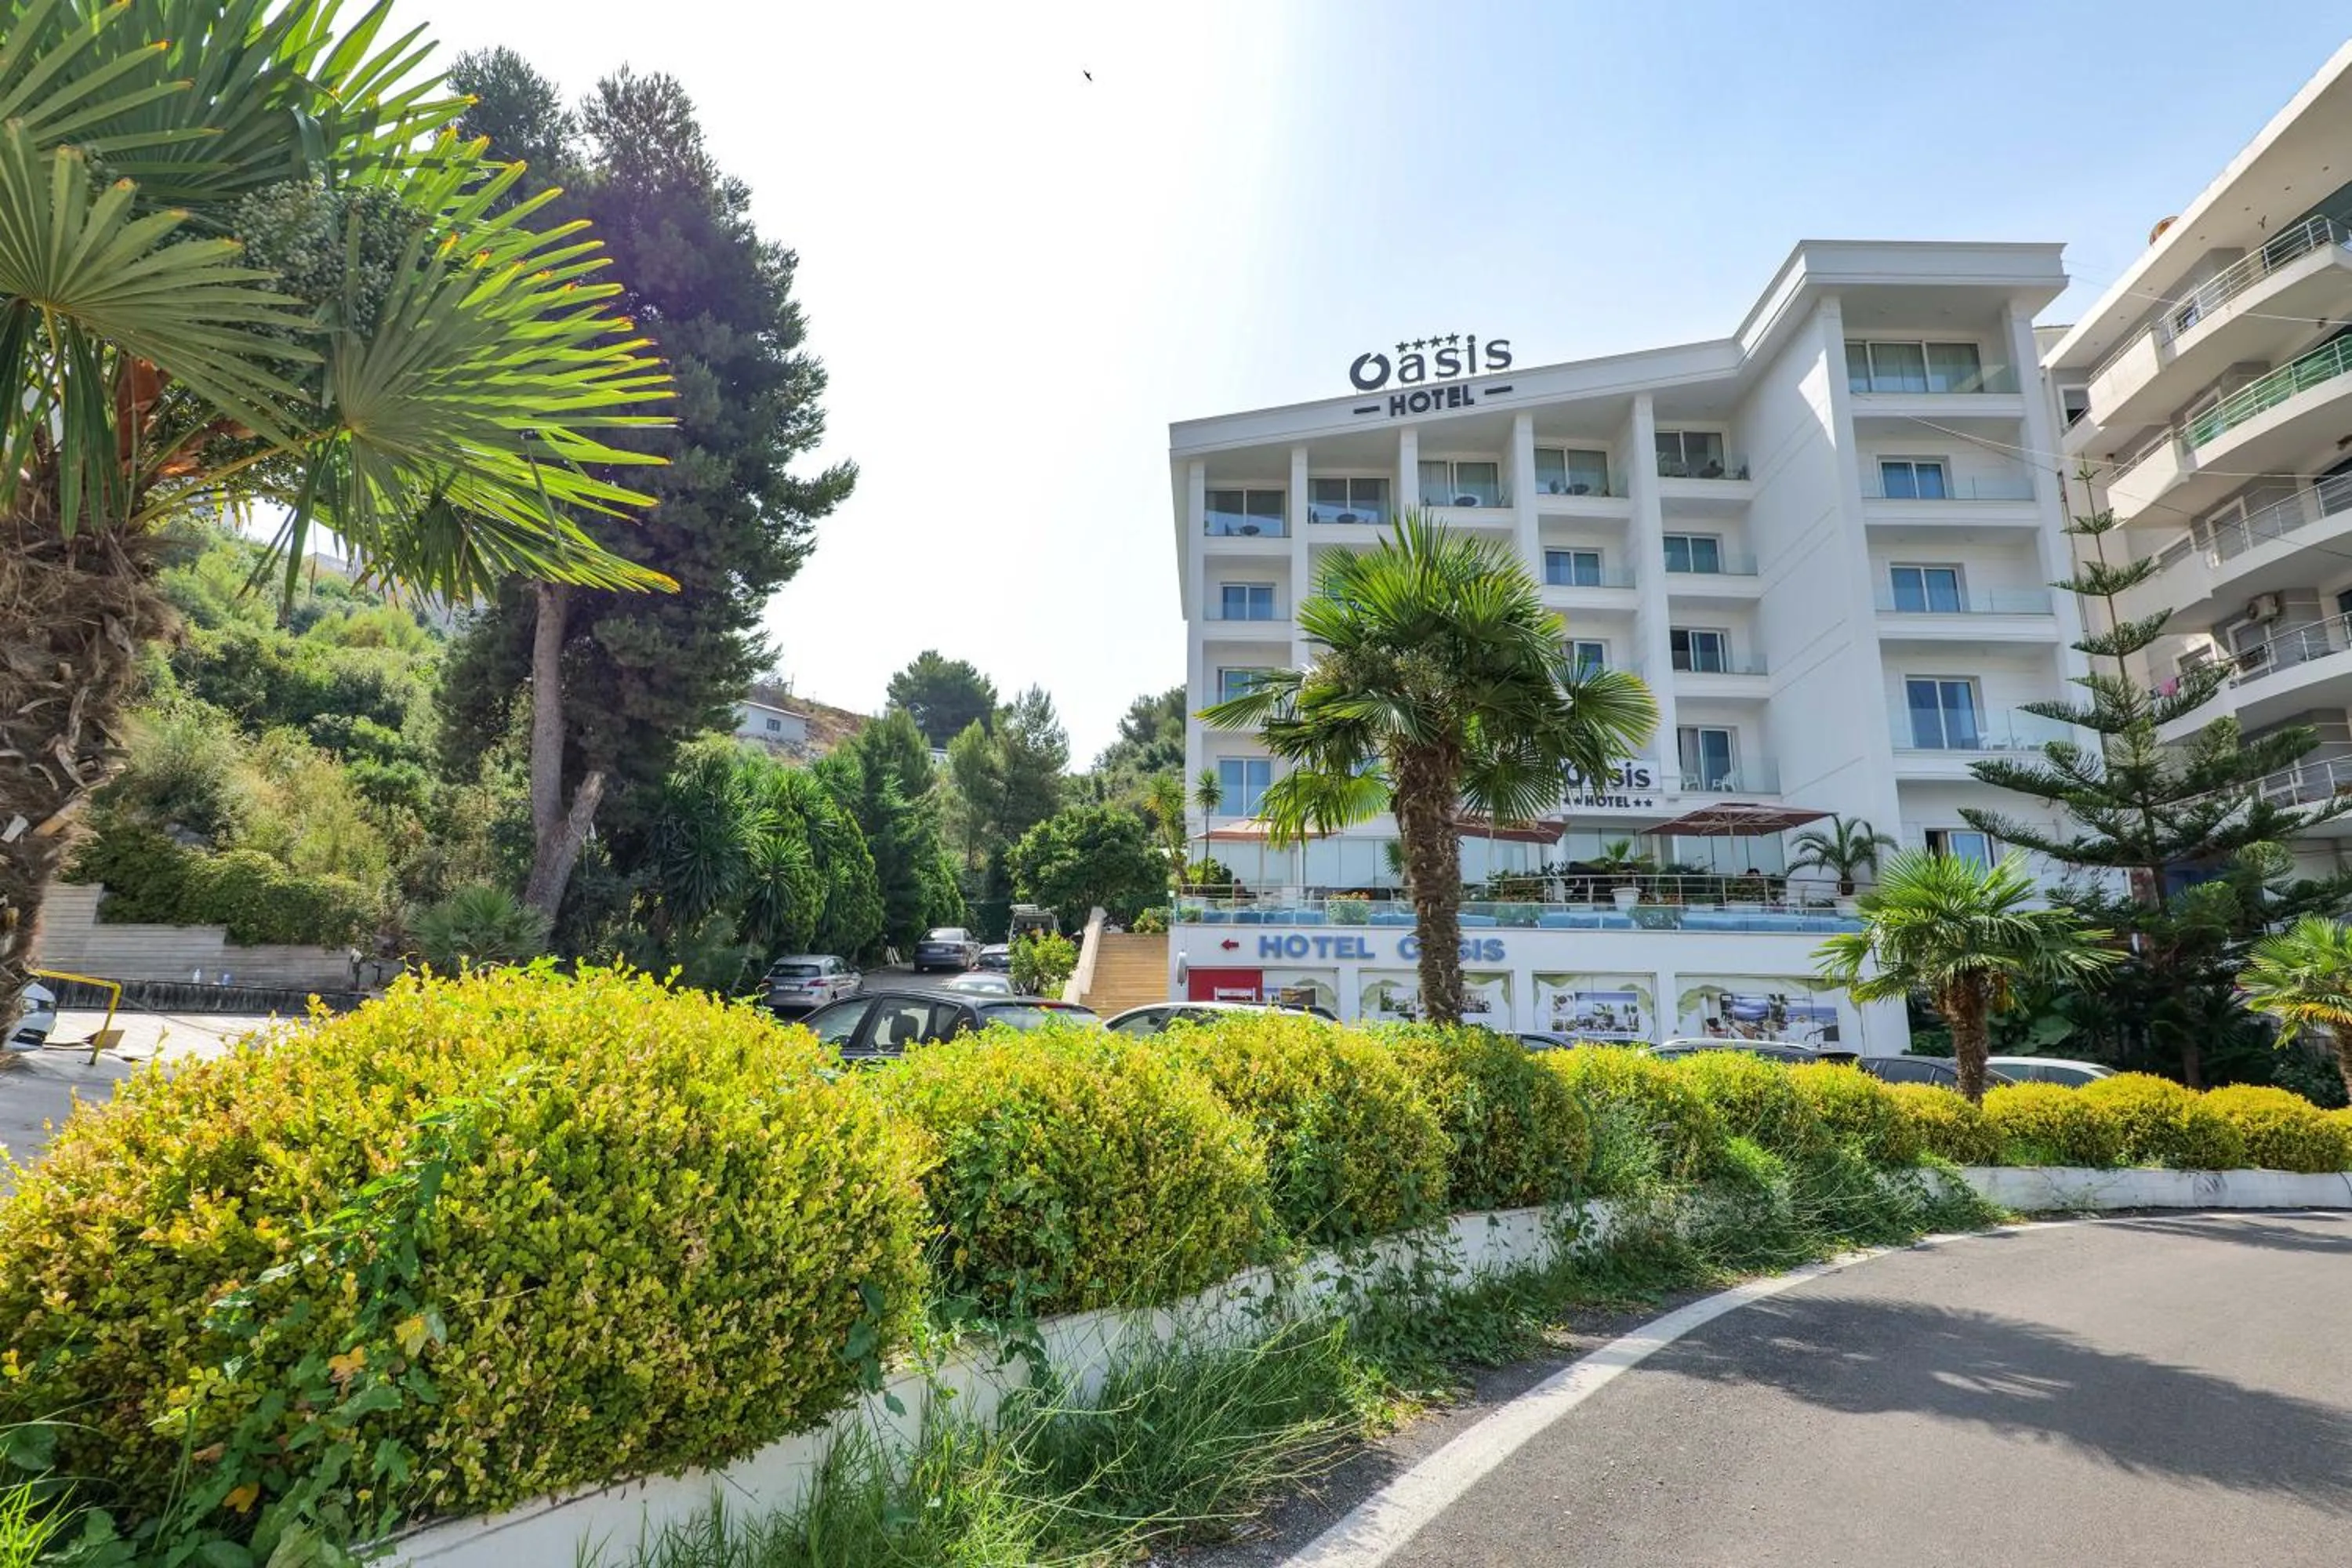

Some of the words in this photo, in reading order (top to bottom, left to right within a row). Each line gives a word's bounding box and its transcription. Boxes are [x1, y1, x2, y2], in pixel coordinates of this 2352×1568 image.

[1349, 335, 1512, 390] Oasis
[1389, 384, 1475, 416] HOTEL
[1565, 761, 1650, 788] Osis
[1584, 795, 1631, 808] HOTEL
[1258, 935, 1375, 959] HOTEL
[1396, 935, 1506, 962] OSIS
